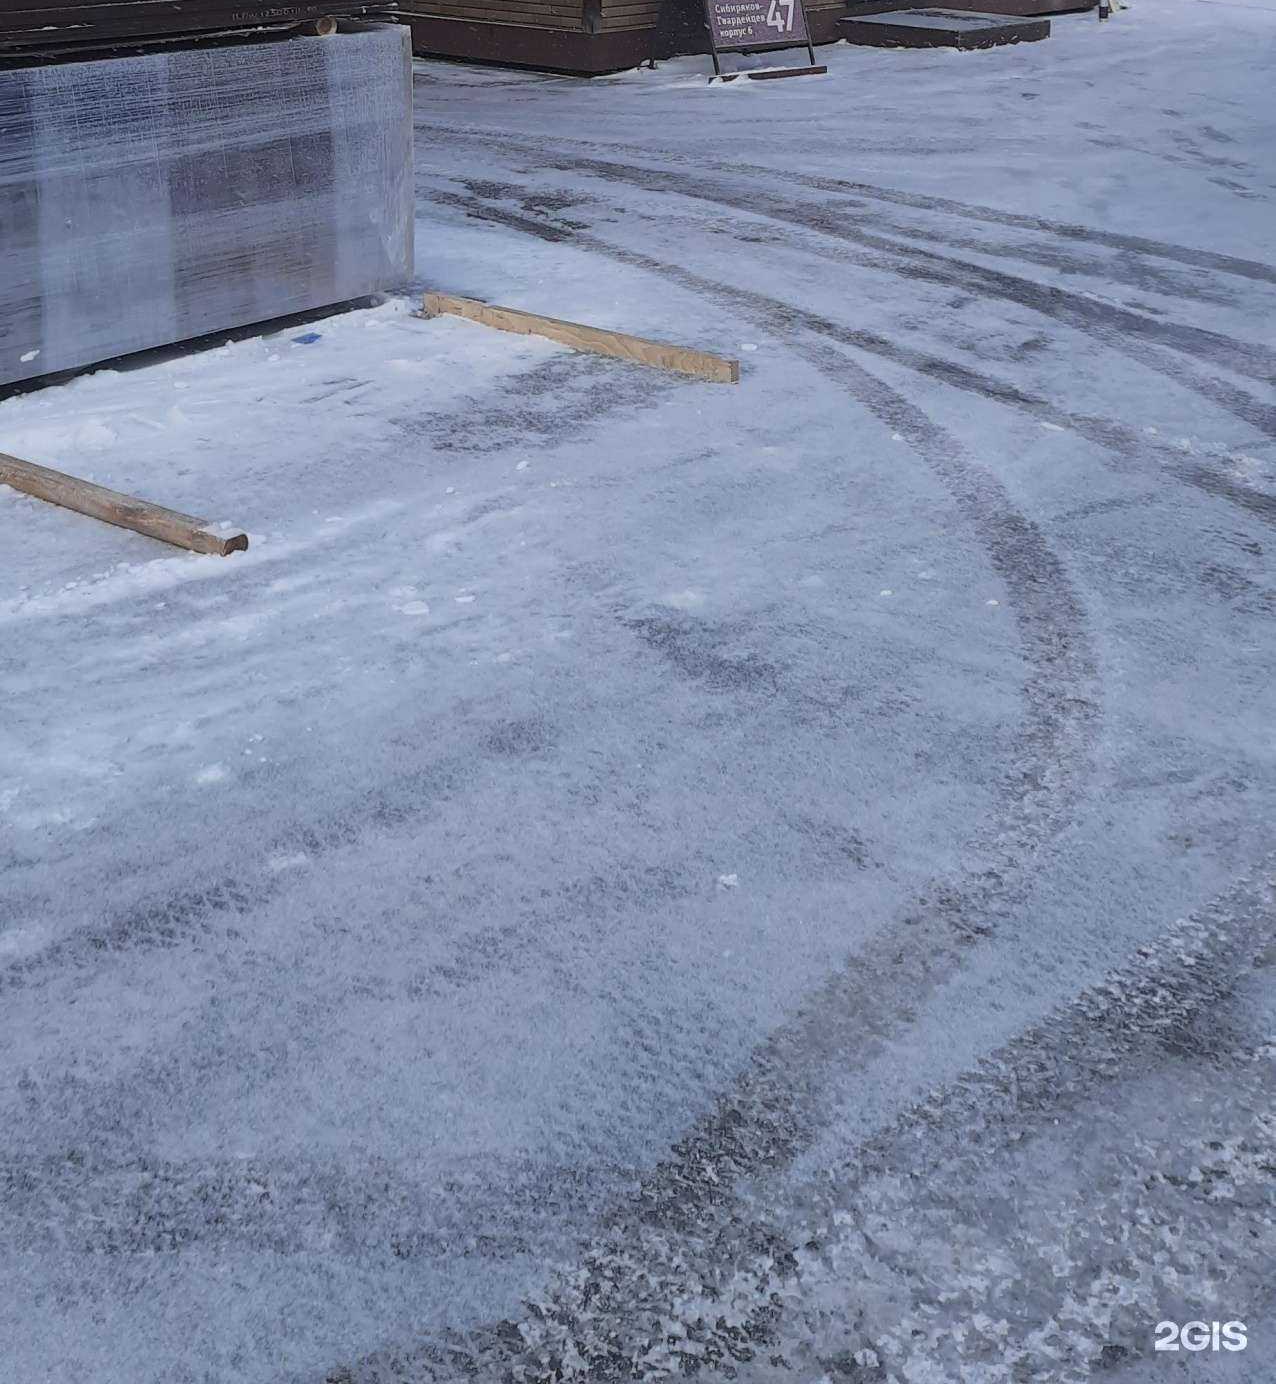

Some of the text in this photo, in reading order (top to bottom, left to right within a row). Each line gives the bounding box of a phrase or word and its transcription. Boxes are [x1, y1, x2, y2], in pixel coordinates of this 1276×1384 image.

[715, 3, 766, 15] Сибиряков-
[717, 14, 766, 27] Гвардейцев
[720, 25, 753, 39] корпус 6
